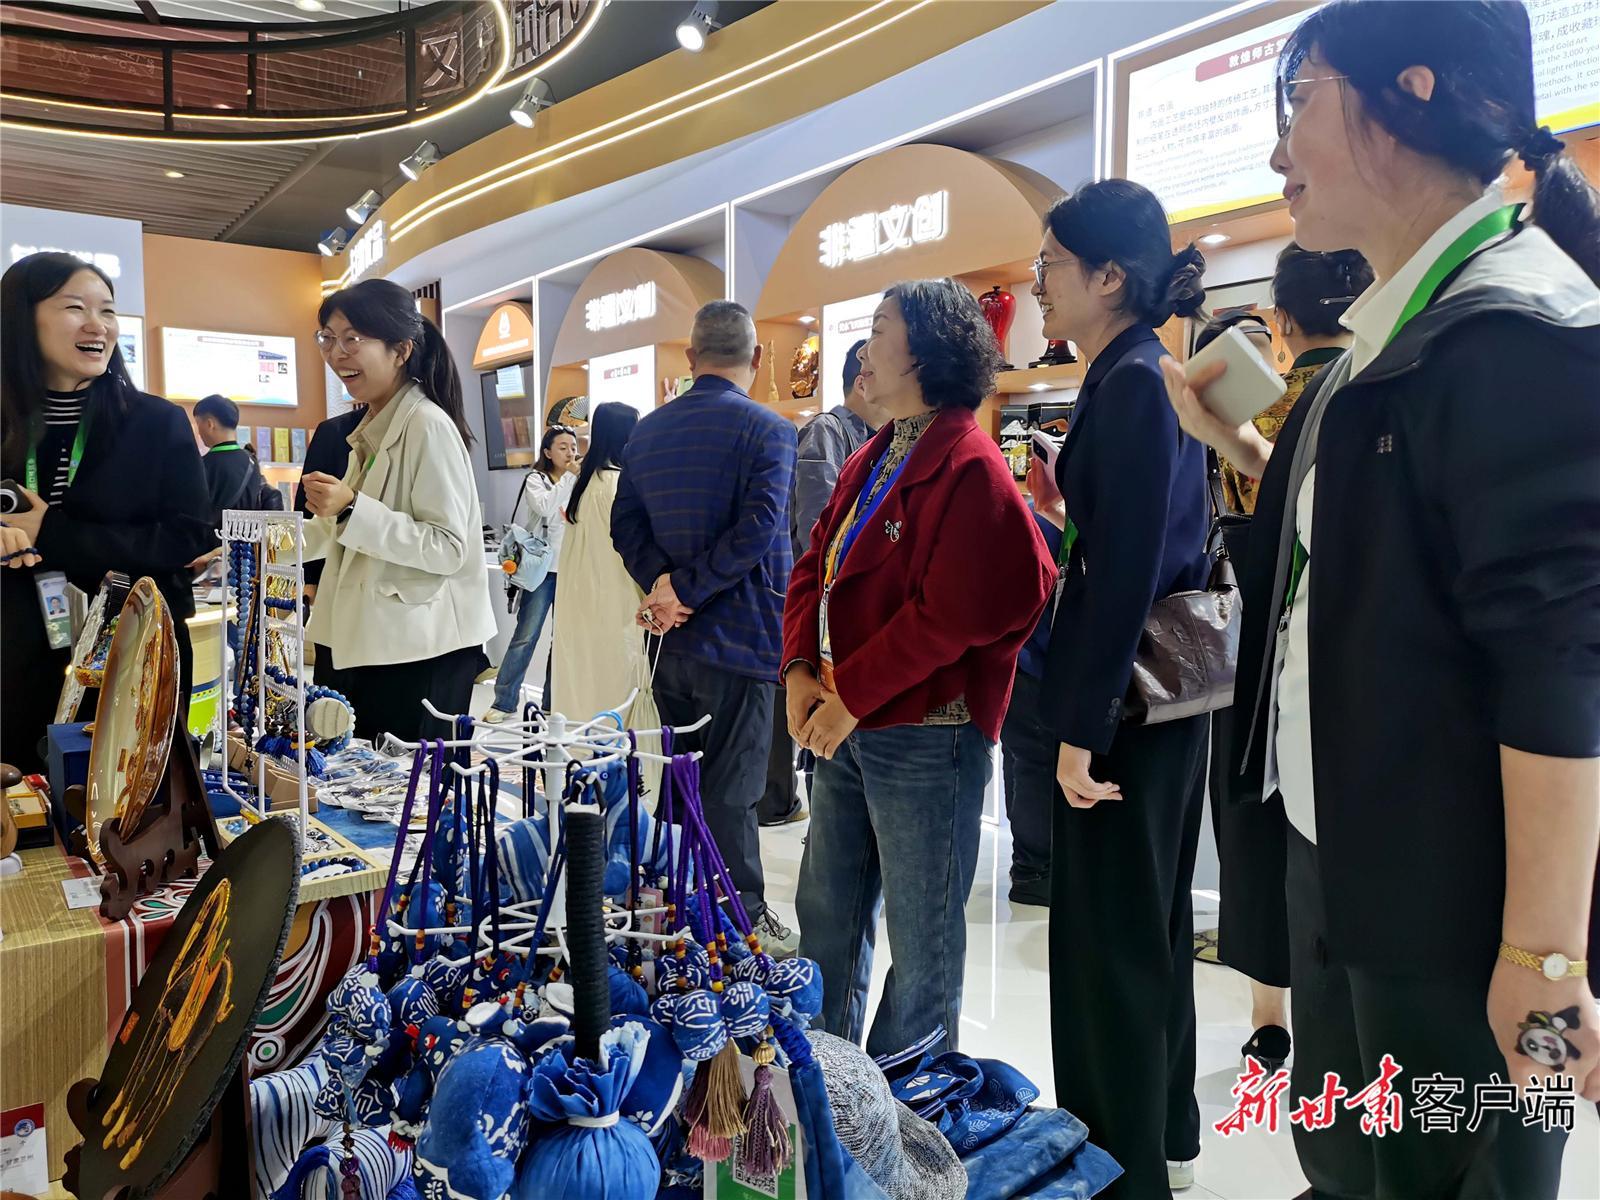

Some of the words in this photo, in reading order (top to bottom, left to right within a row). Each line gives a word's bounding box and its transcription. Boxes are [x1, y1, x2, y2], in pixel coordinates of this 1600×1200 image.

[1565, 56, 1600, 70] reflectio
[819, 189, 948, 268] 非遗文创
